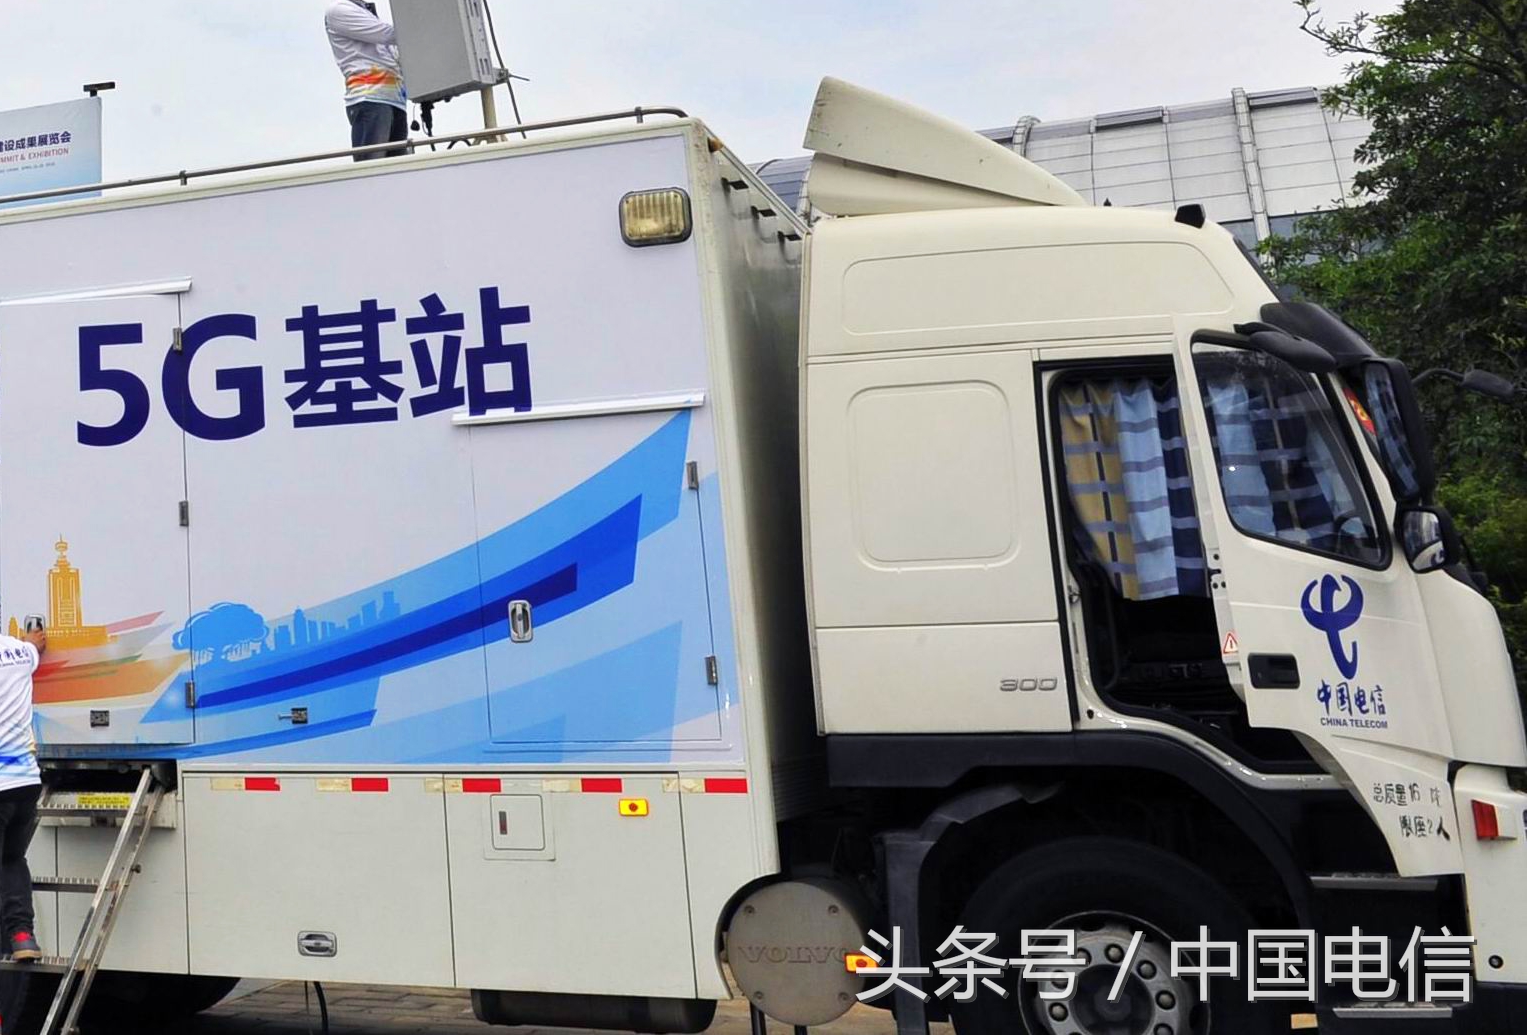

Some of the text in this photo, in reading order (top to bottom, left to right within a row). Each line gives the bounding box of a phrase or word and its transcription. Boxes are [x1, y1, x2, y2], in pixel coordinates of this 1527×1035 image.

[28, 148, 69, 160] EXHIBITION
[77, 286, 533, 446] 5G基站
[1000, 678, 1058, 691] 300
[1317, 679, 1386, 716] 中国电信
[1320, 717, 1388, 729] CHINA TELECOM
